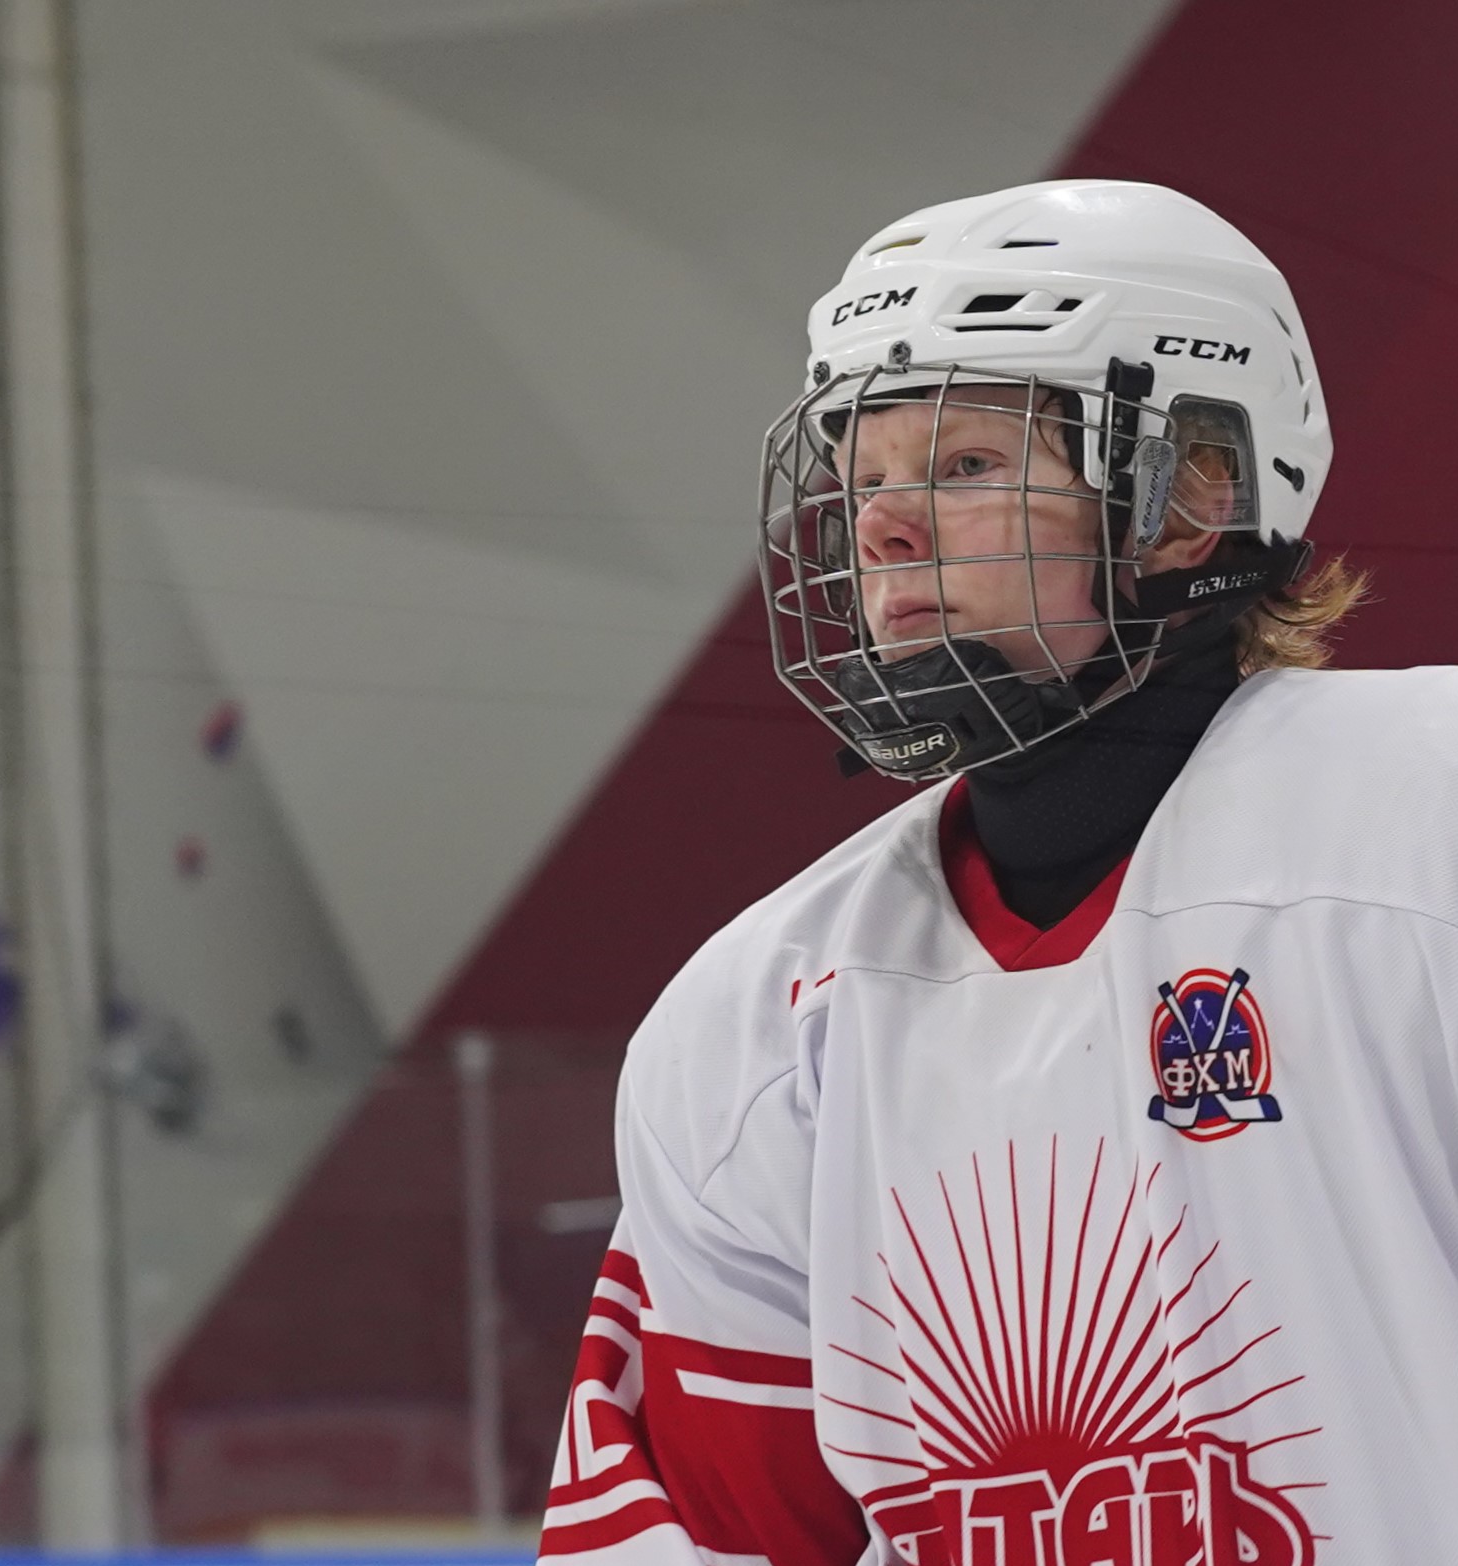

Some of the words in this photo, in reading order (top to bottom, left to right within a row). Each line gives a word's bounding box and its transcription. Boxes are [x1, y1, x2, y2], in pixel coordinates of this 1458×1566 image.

[831, 285, 918, 327] CCM
[1152, 334, 1251, 365] CCM
[869, 732, 946, 761] BAUER
[1162, 1047, 1253, 1097] ФХМ
